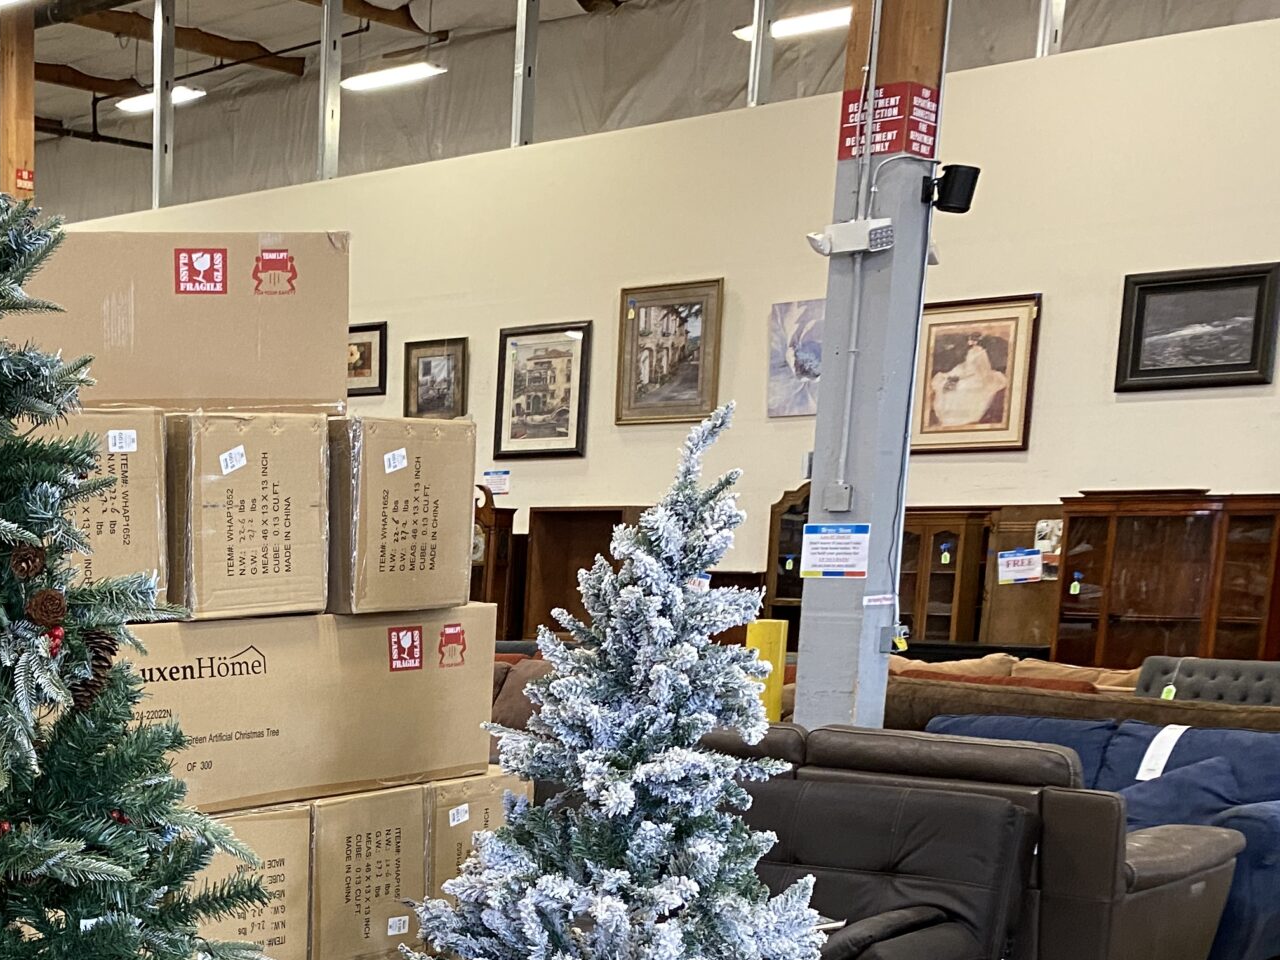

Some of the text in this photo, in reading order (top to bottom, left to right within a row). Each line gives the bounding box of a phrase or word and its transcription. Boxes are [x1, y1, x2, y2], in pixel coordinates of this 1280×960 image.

[849, 96, 901, 112] DEATMENT
[846, 130, 898, 146] DEATMENT
[180, 253, 189, 282] GLASS
[214, 253, 222, 282] GLASS
[180, 282, 222, 291] FRAGILE
[120, 453, 130, 546] ITEM#: WHAP1652
[429, 544, 437, 570] MADE
[1005, 558, 1035, 569] FREE
[139, 645, 267, 683] uxenHöme
[392, 659, 419, 668] FRAGILE
[208, 731, 233, 743] Artificial
[234, 729, 265, 741] Christmas
[267, 728, 280, 736] Tree
[187, 760, 212, 772] OF 300
